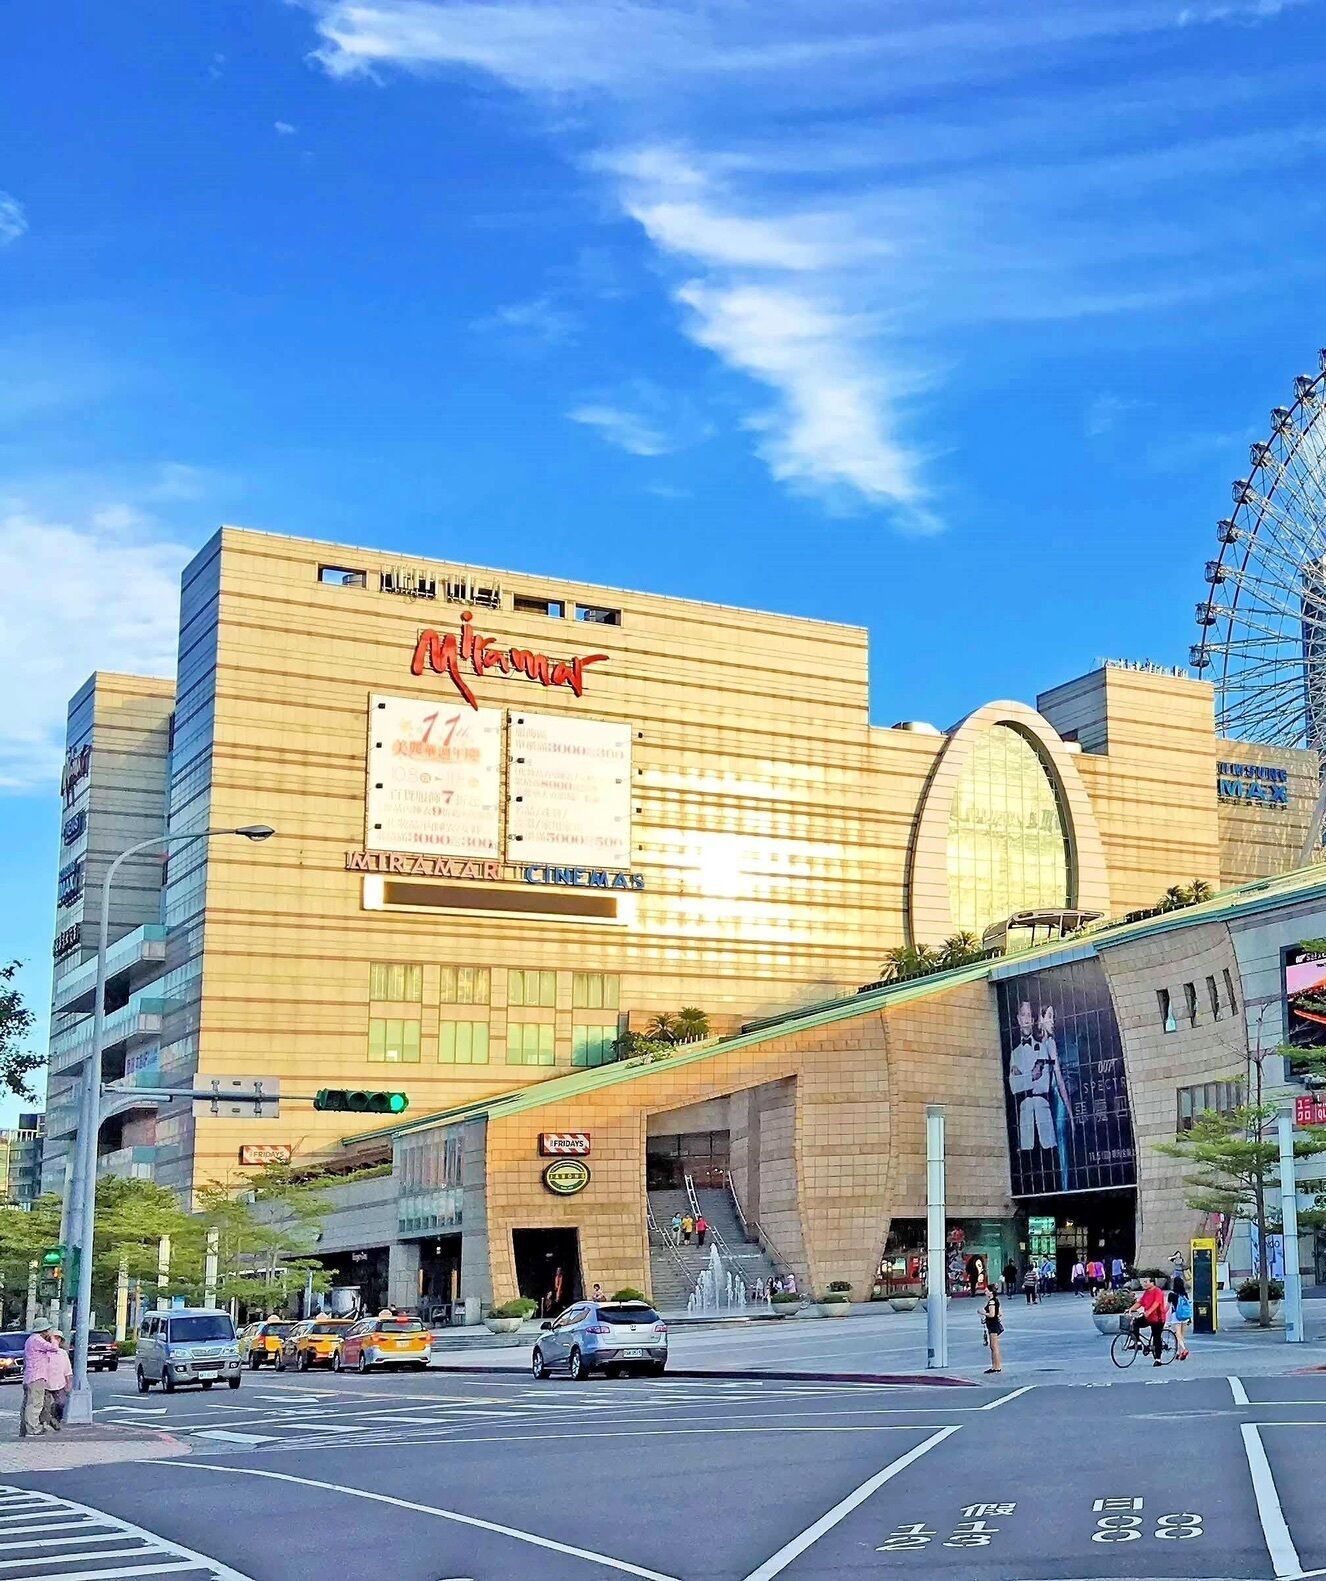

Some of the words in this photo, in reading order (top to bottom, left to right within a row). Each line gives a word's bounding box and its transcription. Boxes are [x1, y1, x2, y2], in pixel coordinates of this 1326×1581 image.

[411, 611, 609, 711] Miramar
[349, 851, 499, 880] MIRAMAR
[525, 864, 645, 890] CINEMAS
